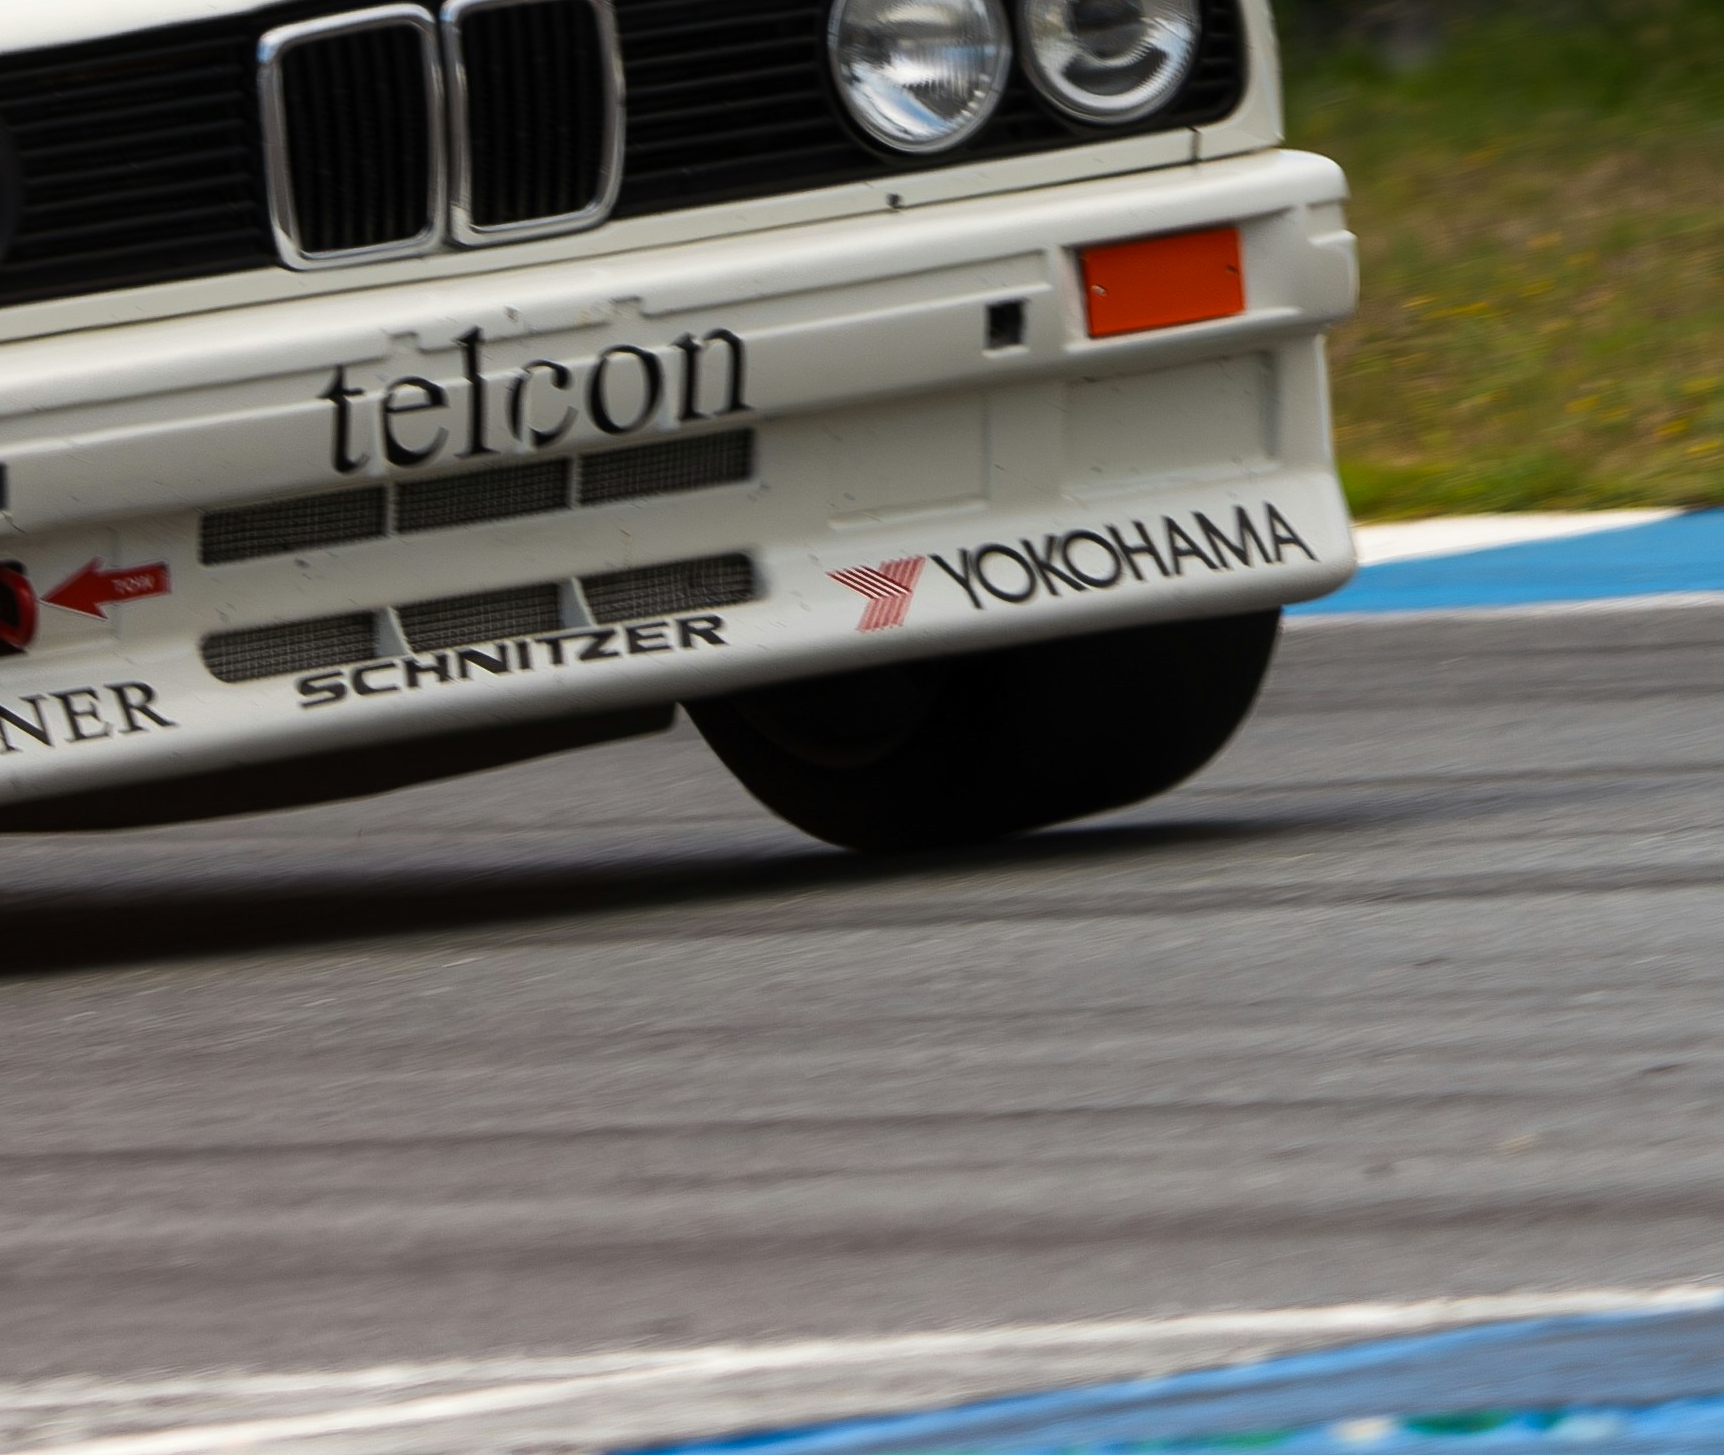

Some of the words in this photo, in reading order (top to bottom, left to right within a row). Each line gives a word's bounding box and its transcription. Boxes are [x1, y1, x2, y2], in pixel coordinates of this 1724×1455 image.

[316, 325, 754, 476] telcon
[928, 501, 1319, 611] YOKOHAMA
[296, 612, 731, 709] SCHNITZER
